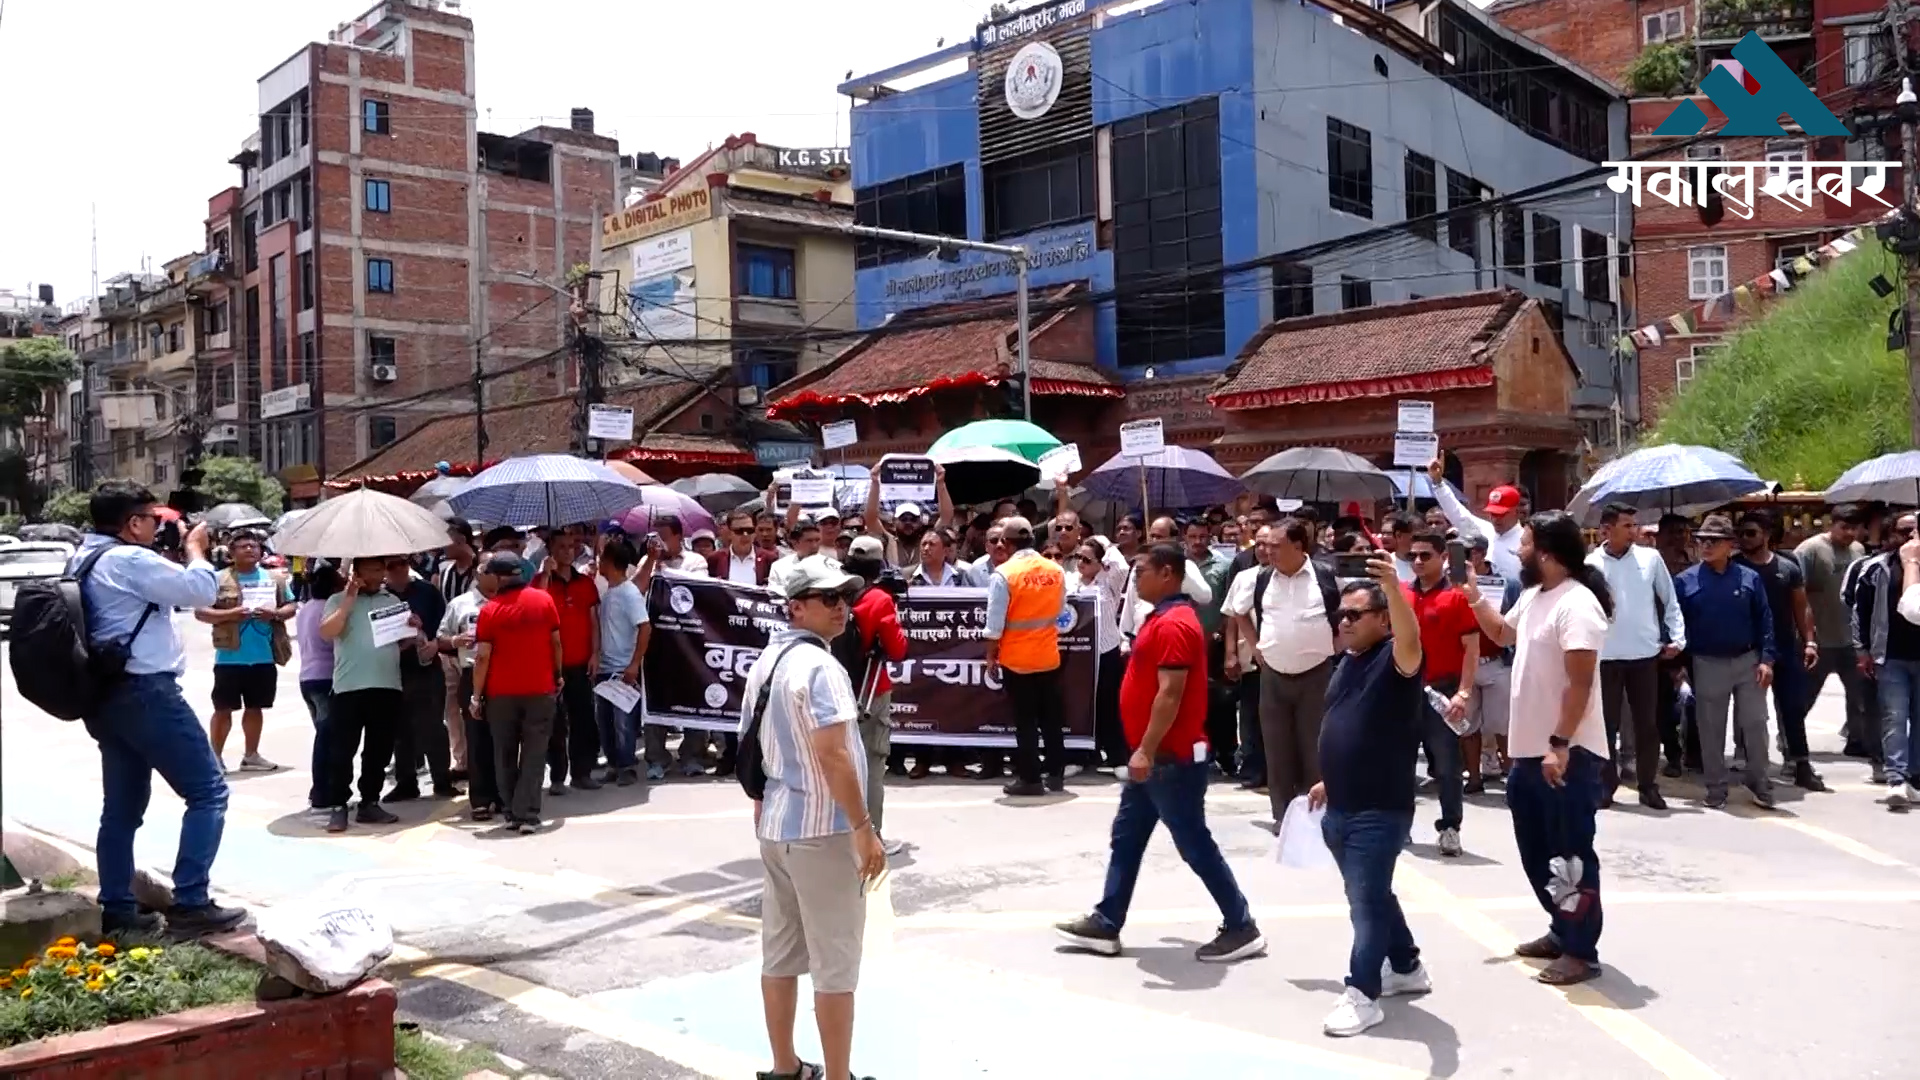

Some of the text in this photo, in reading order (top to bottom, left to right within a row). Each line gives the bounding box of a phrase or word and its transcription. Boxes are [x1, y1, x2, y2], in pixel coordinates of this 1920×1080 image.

[779, 149, 851, 166] K.G. STU
[625, 202, 668, 229] DIGITAL
[671, 188, 708, 215] PHOTO
[758, 446, 799, 459] HANTI
[935, 610, 956, 624] कर
[703, 642, 764, 683] बृह
